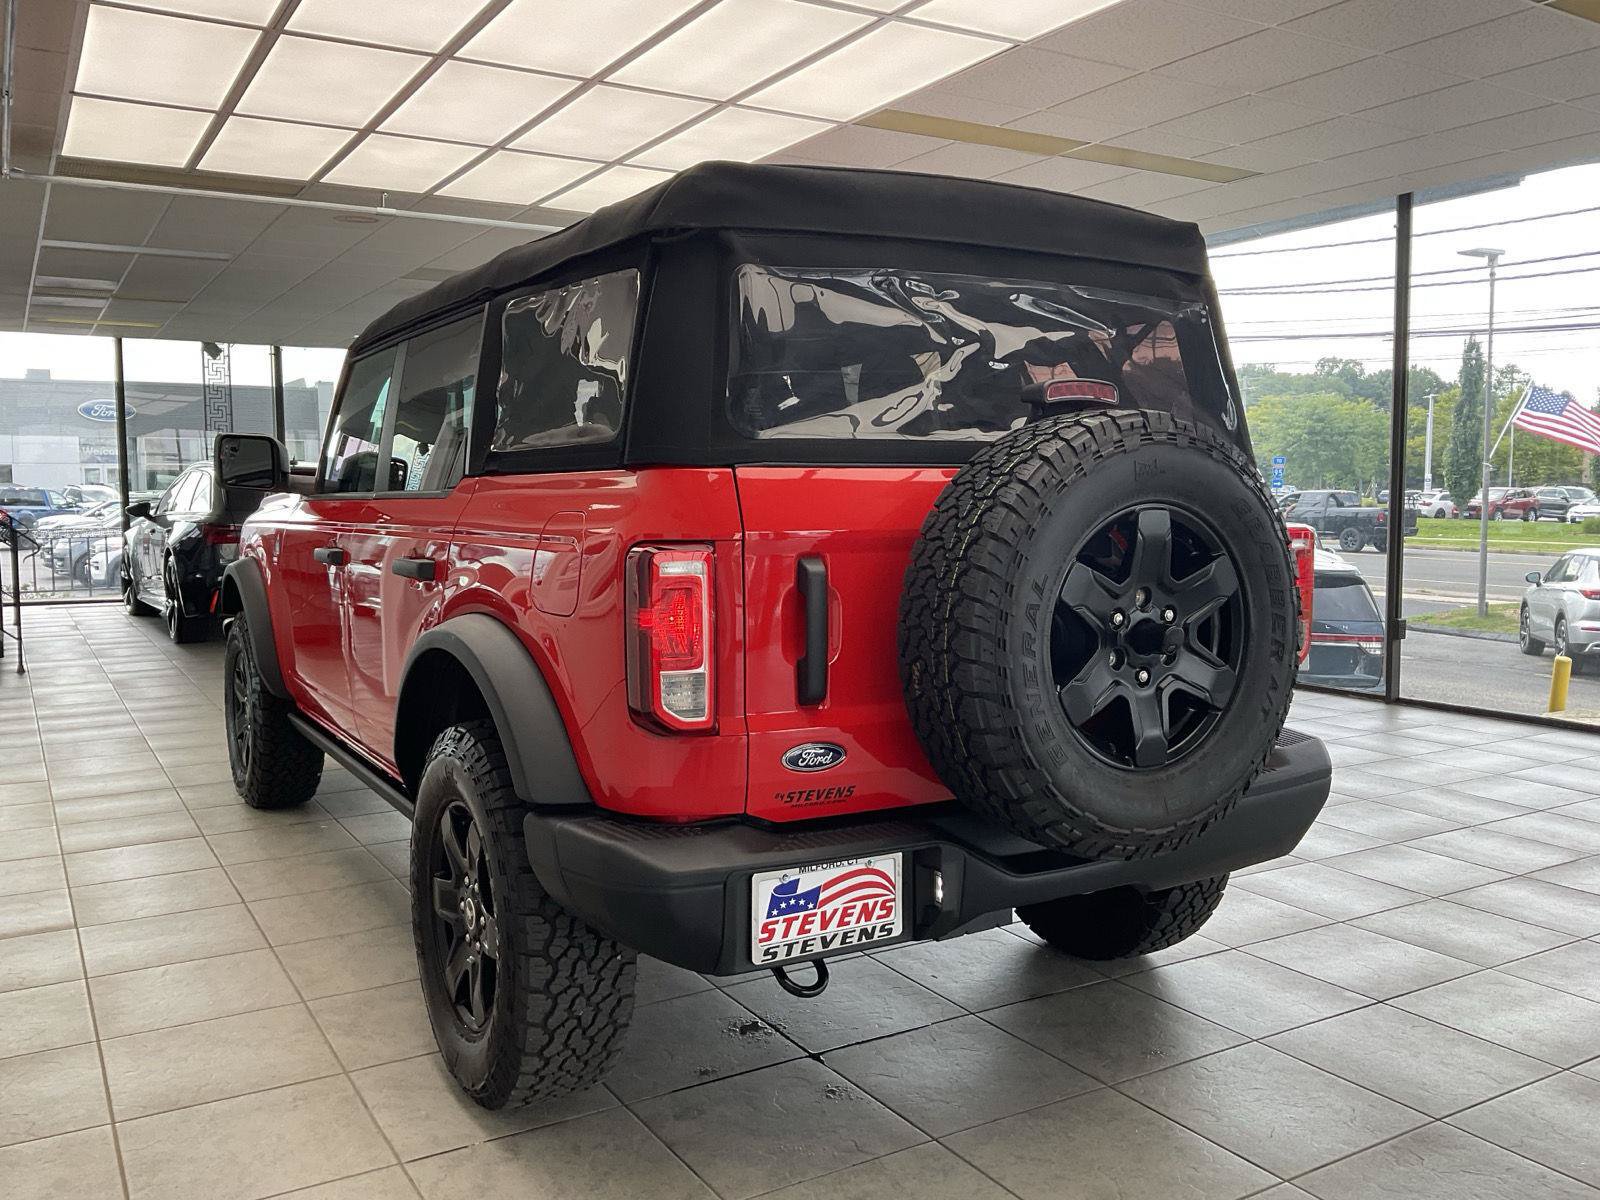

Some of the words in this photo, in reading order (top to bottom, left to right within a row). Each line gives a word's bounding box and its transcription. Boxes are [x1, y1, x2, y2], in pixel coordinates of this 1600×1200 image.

[91, 404, 117, 417] For
[82, 446, 117, 456] Welco
[1022, 573, 1067, 766] GENERAL
[798, 748, 833, 767] Ford
[784, 785, 856, 804] STEVENS
[758, 897, 896, 944] STEVENS
[761, 921, 895, 963] STEVENS
